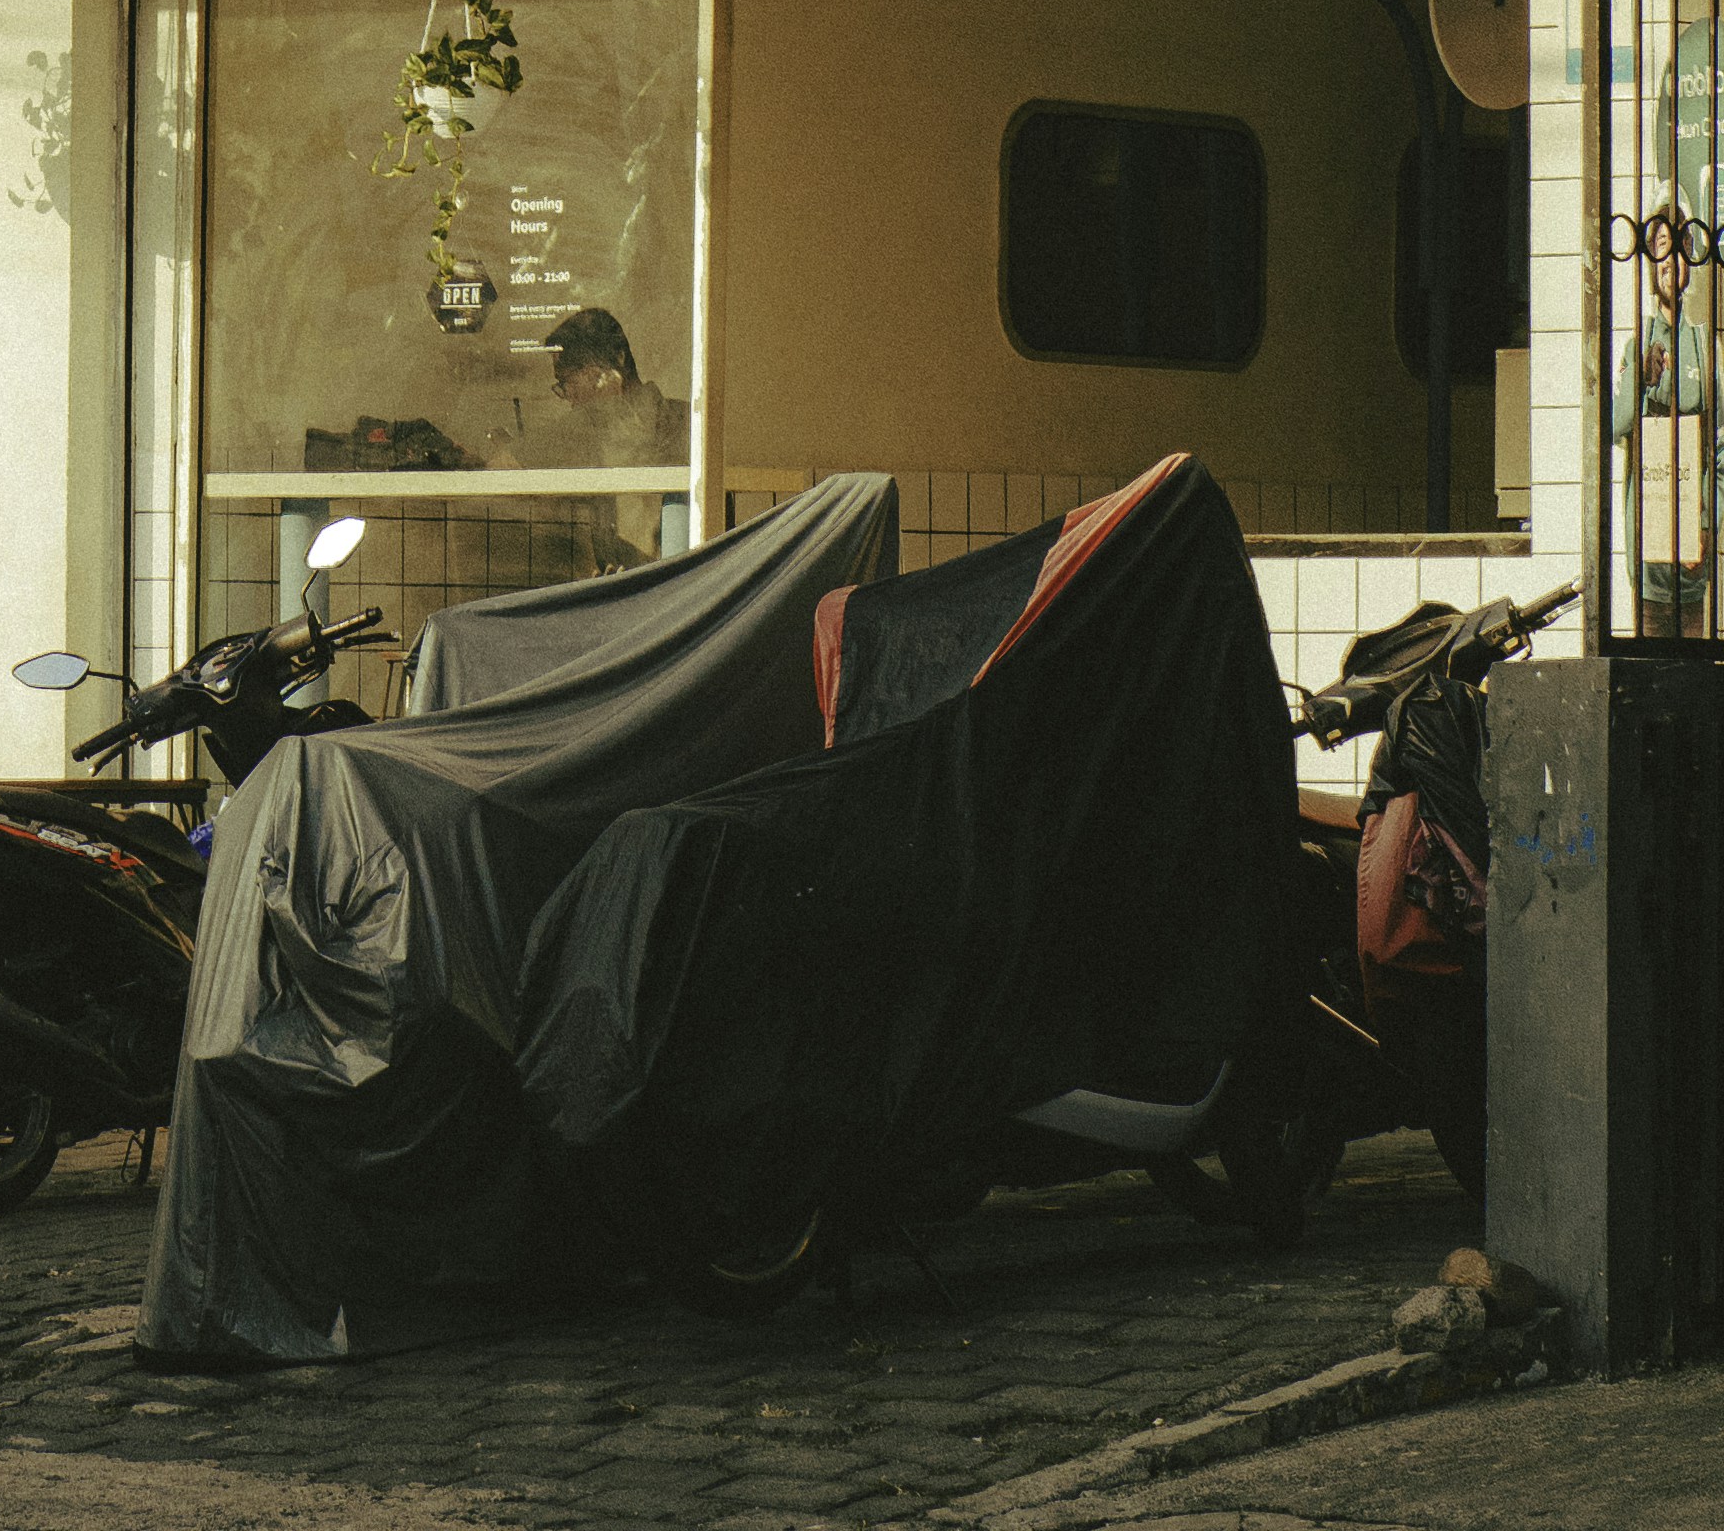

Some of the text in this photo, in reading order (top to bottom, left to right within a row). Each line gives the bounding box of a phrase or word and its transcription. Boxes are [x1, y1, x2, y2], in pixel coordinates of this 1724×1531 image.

[510, 195, 564, 215] Opening
[510, 219, 548, 234] Hours
[442, 287, 481, 305] OPEN
